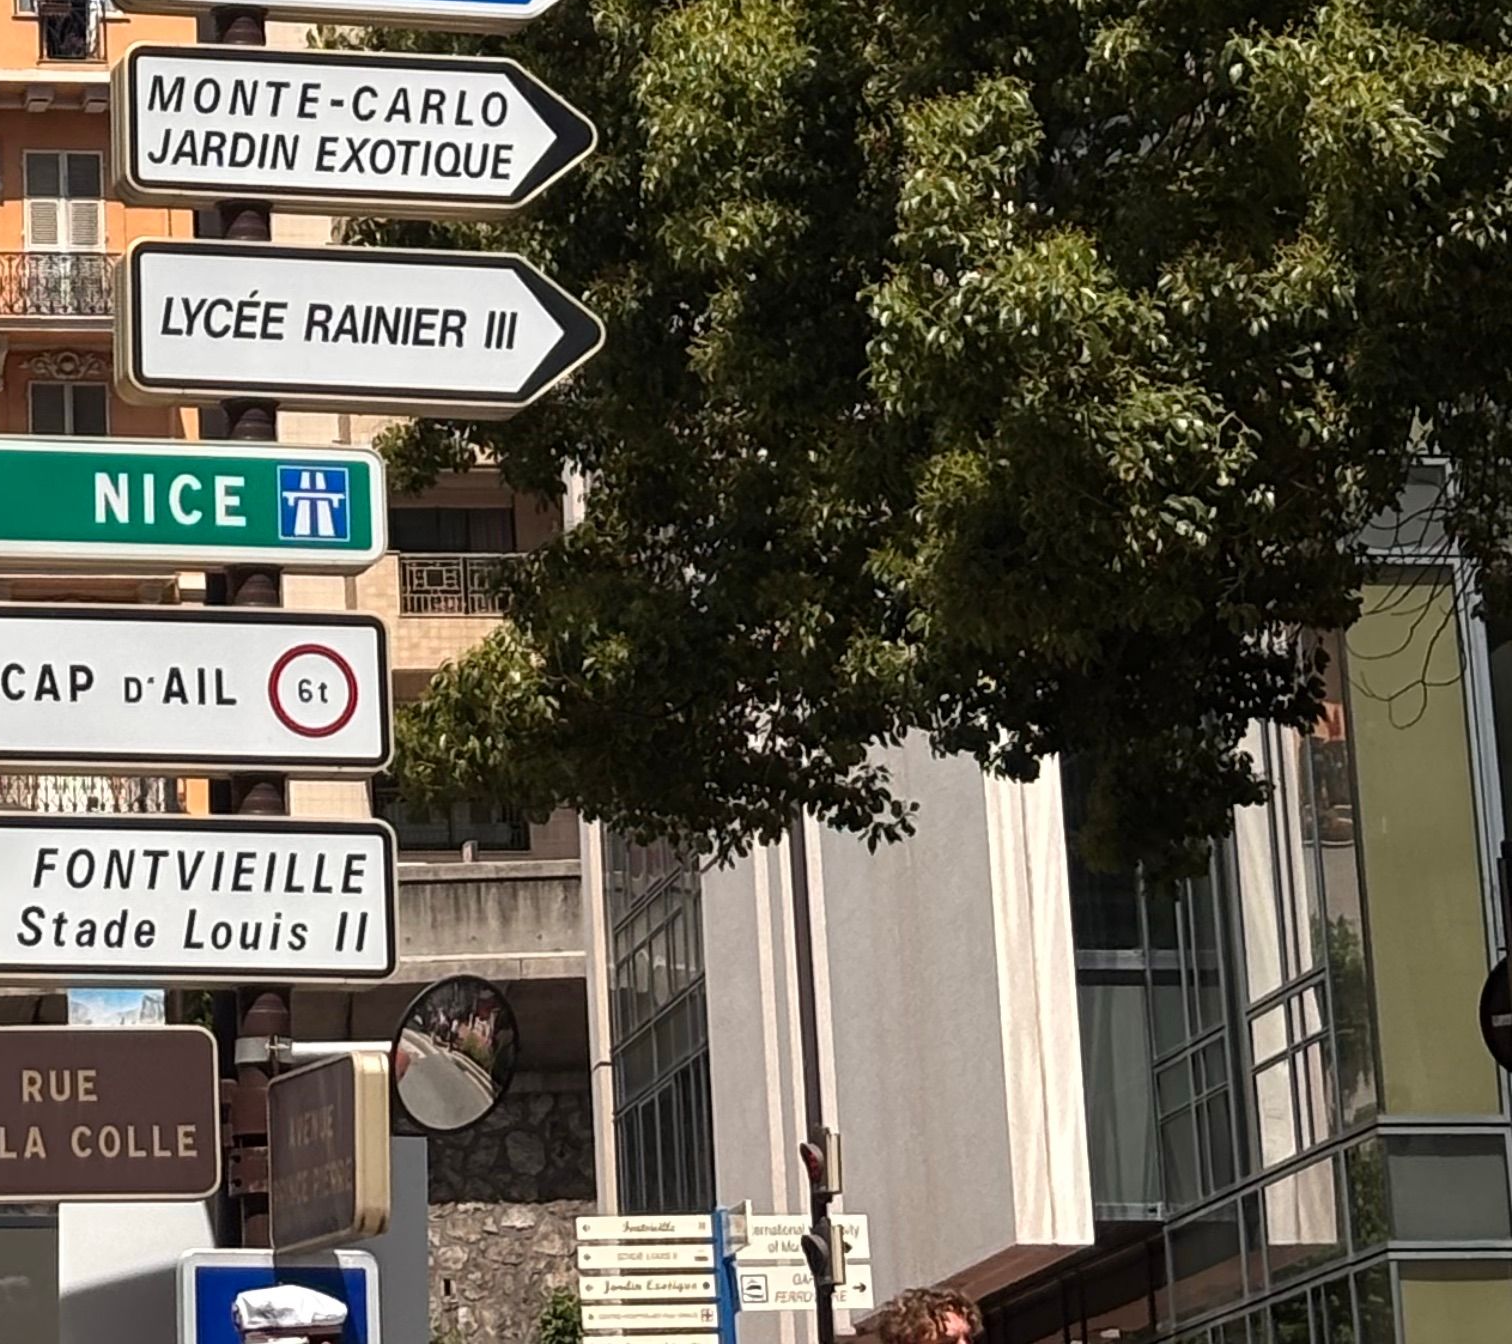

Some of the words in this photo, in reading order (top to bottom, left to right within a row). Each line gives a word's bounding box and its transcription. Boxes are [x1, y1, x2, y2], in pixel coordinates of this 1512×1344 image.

[147, 75, 509, 128] MONTE-CARLO
[147, 127, 299, 171] JARDIN
[315, 134, 514, 180] EXOTIQUE
[161, 289, 288, 341] LYCÉE
[304, 302, 468, 348] RAINIER
[484, 310, 518, 350] III
[93, 472, 247, 527] NICE
[0, 662, 95, 703] CAP
[297, 678, 328, 704] 6t
[33, 847, 368, 895] FONTVIEILLE
[15, 905, 157, 949] Stade
[182, 908, 309, 952] Louis
[334, 911, 369, 953] II
[20, 1069, 99, 1103] RUE
[70, 1124, 198, 1159] COLLE
[752, 1223, 805, 1236] ernational
